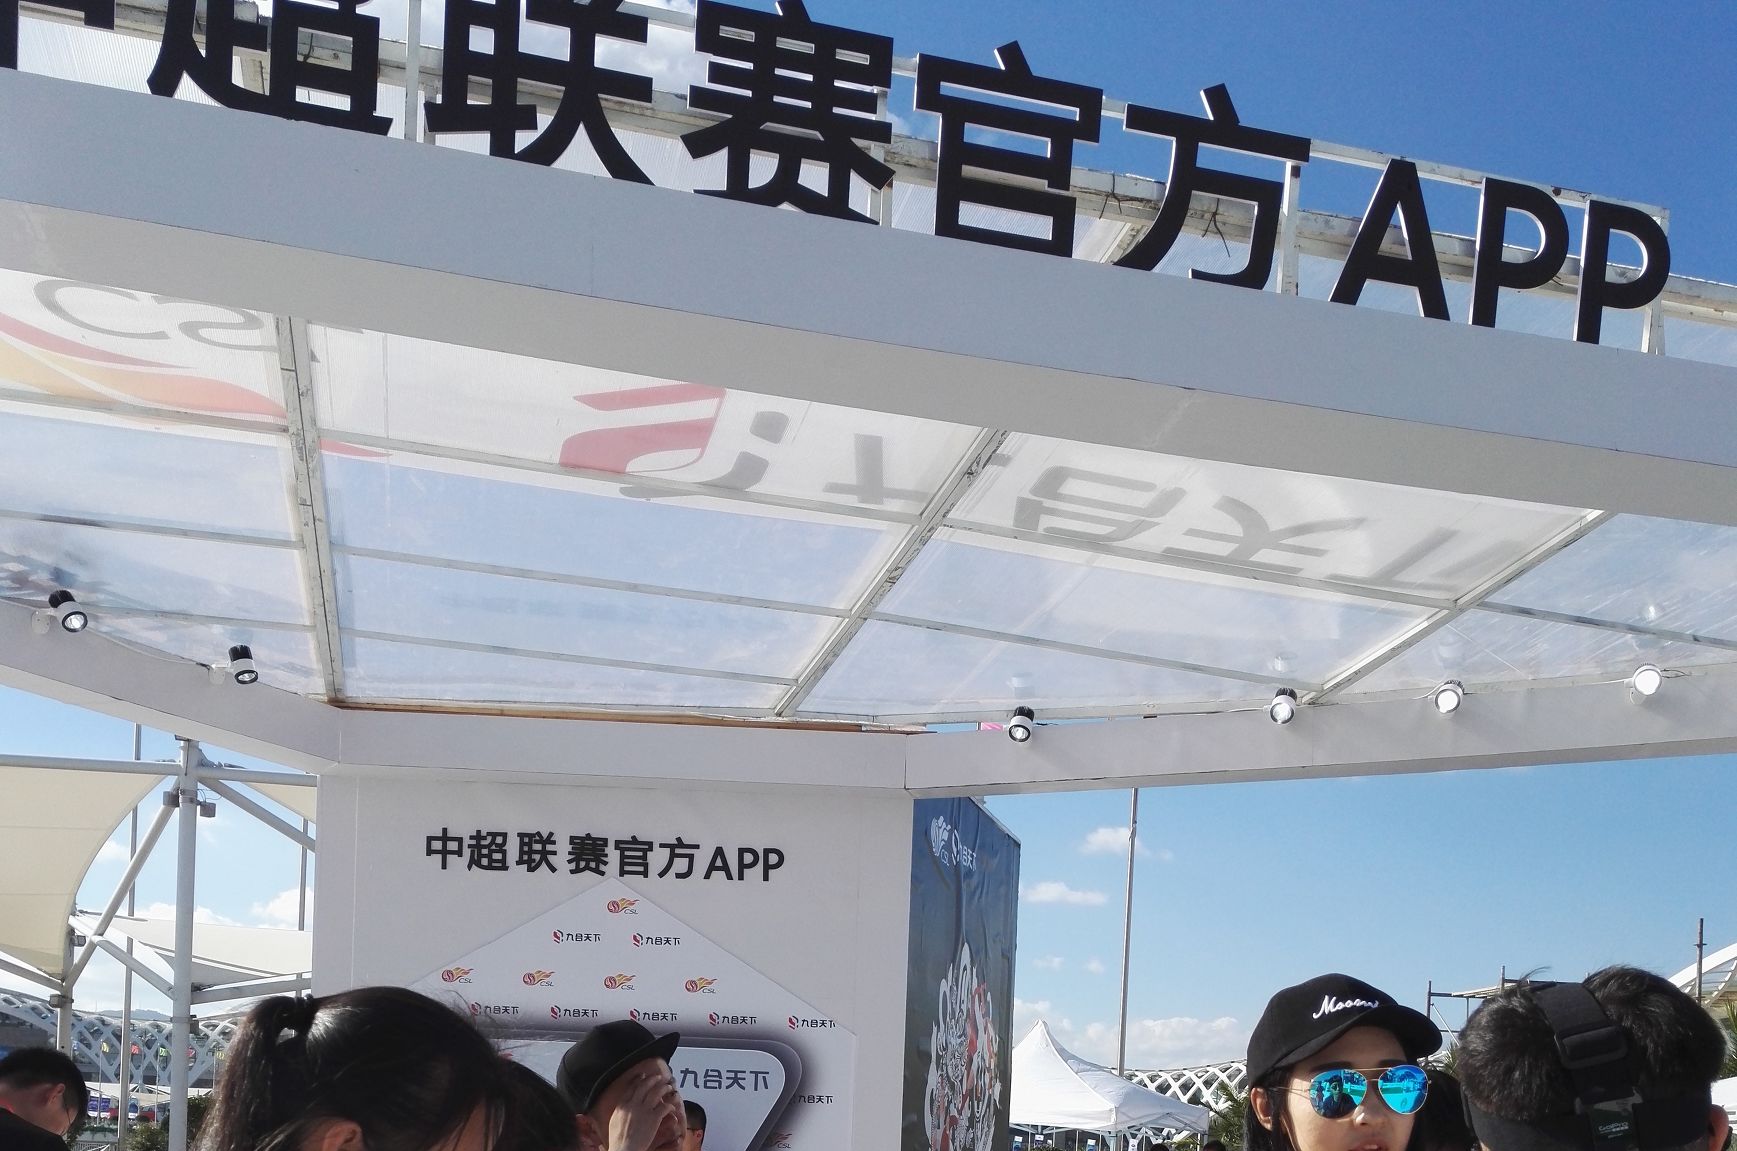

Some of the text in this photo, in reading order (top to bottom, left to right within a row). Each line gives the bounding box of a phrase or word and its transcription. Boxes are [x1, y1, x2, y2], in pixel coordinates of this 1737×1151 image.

[426, 828, 785, 882] 中超联赛官方APP
[565, 932, 601, 943] 九合天下
[645, 936, 681, 946] 九合天下
[563, 1008, 599, 1019] 九合天下
[642, 1011, 678, 1022] 九合天下
[721, 1015, 757, 1025] 九合天下
[801, 1018, 836, 1029] 九合天下
[680, 1067, 770, 1092] 九合天下
